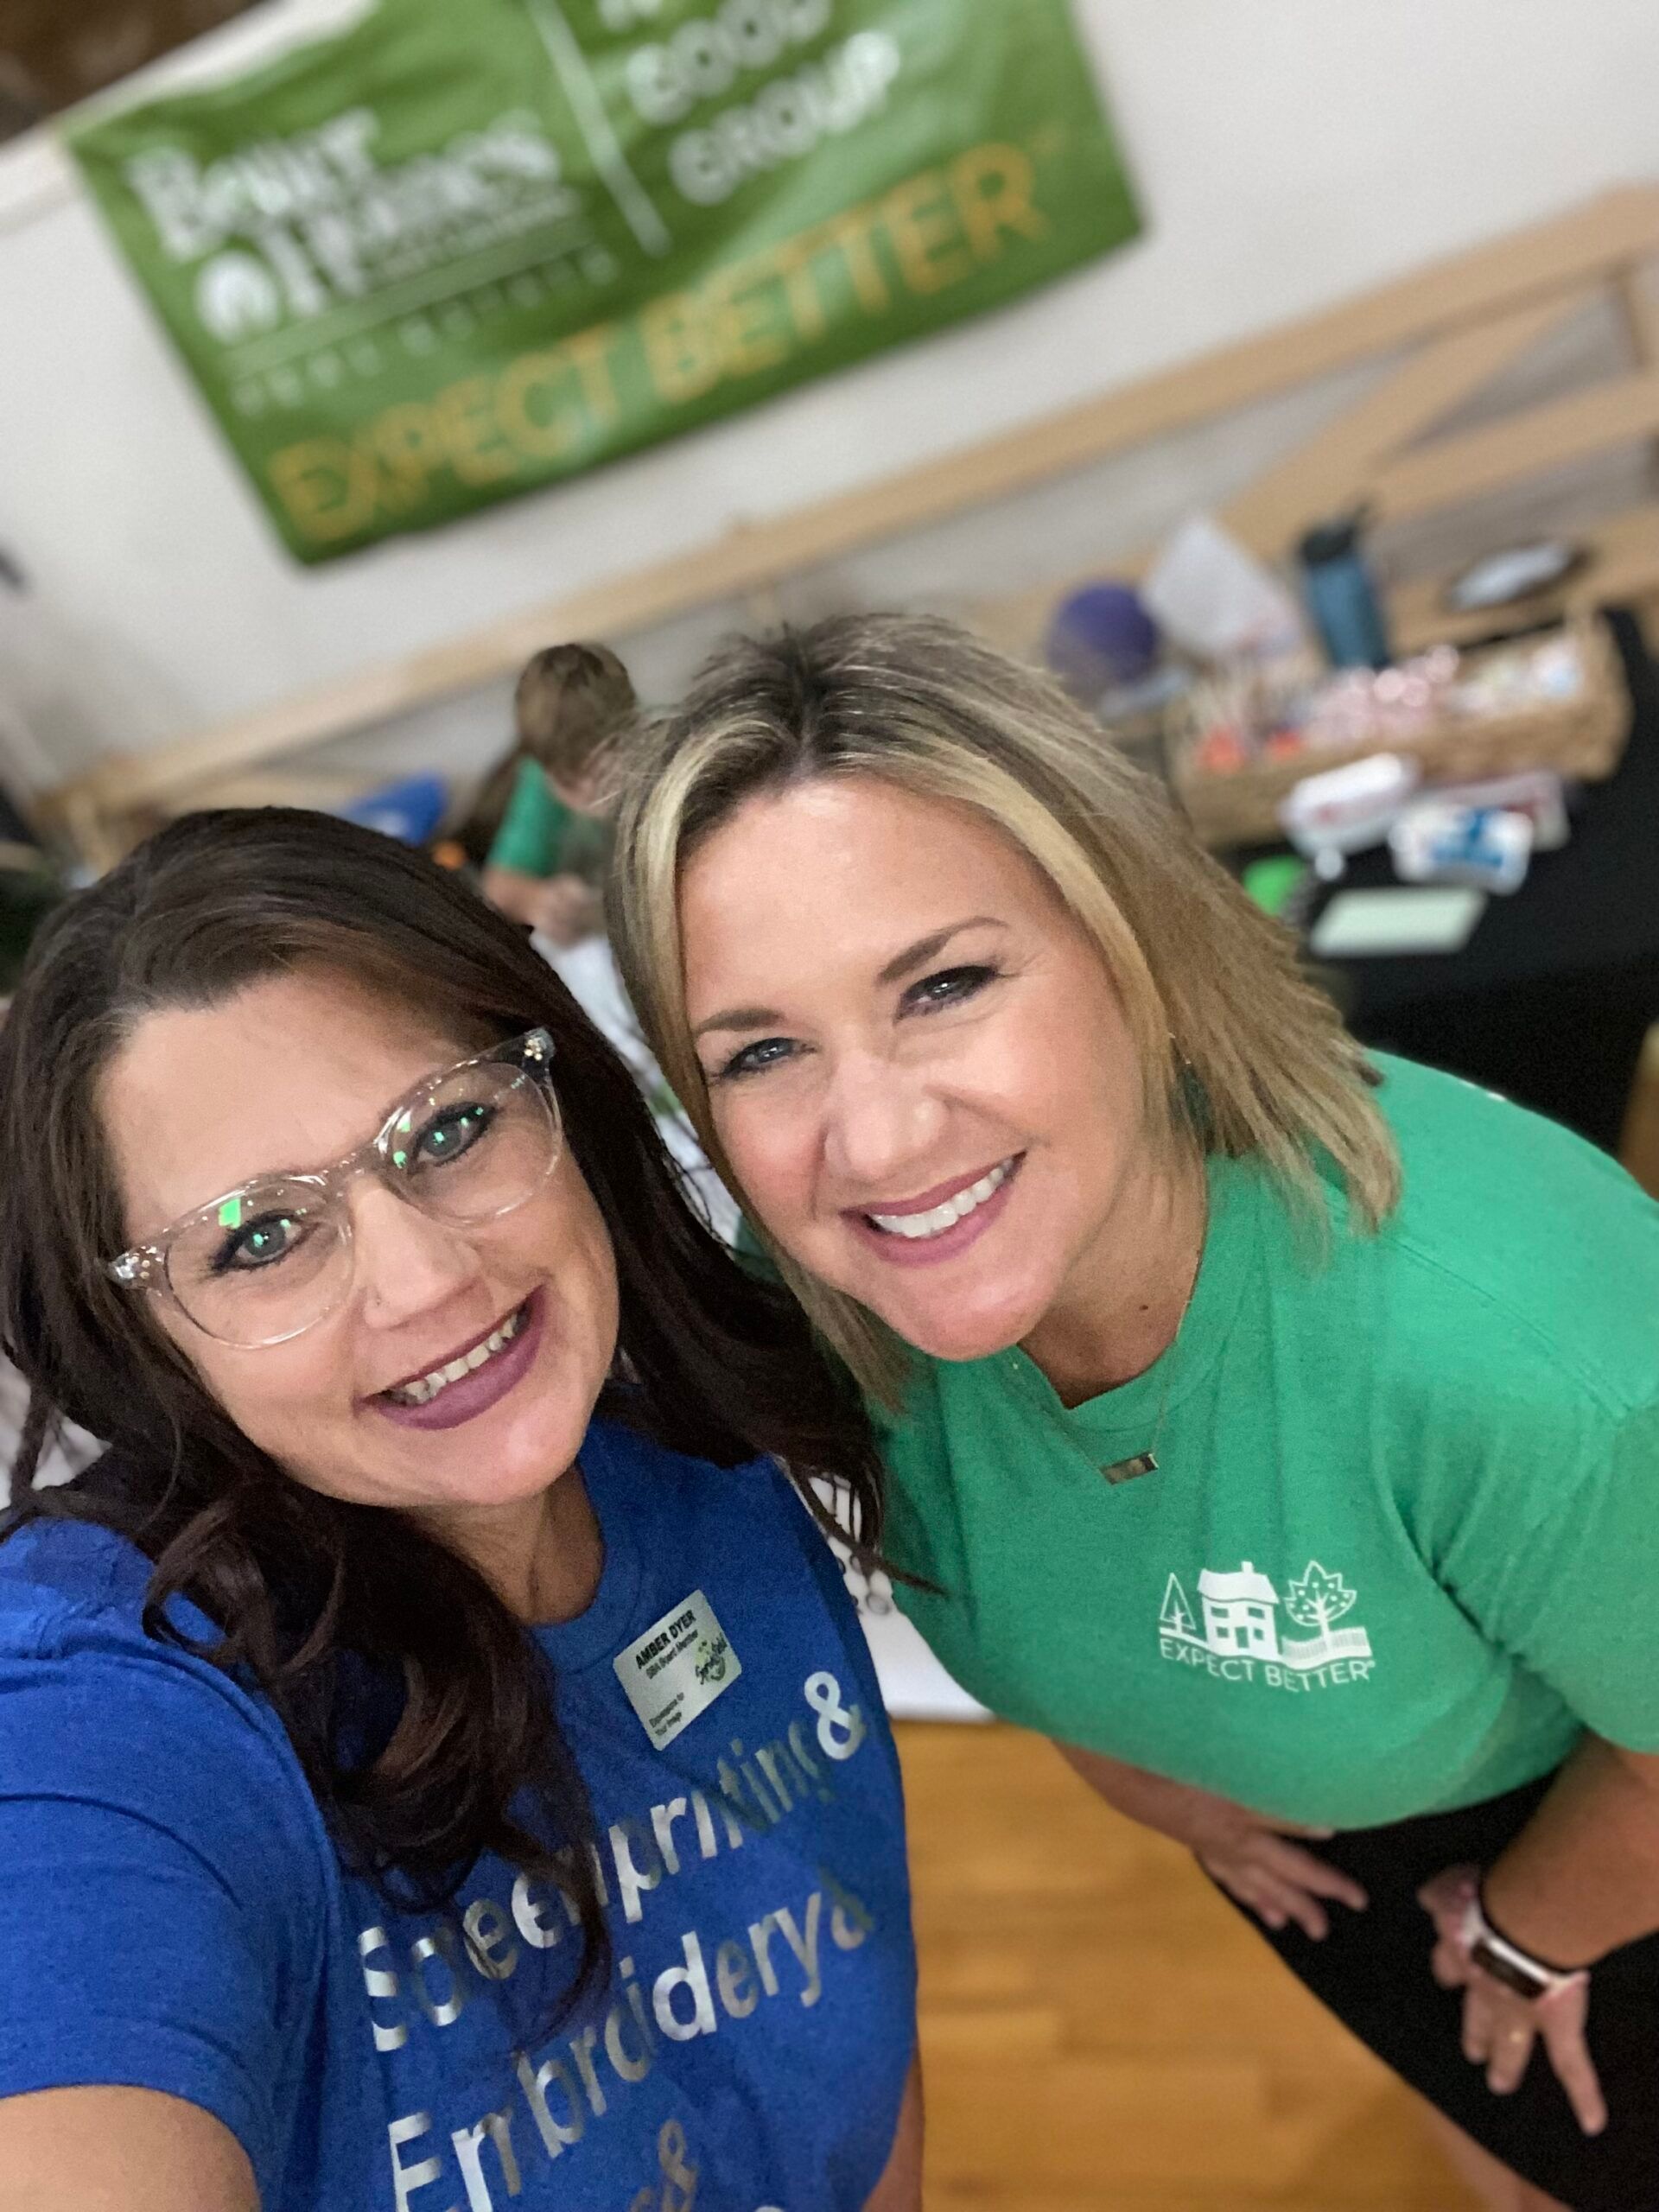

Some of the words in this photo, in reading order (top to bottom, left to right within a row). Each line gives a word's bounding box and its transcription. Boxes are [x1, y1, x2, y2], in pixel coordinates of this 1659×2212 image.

[668, 29, 901, 207] GROUP
[268, 324, 624, 543] EXPECT
[636, 142, 1052, 406] BETTER
[635, 1632, 671, 1669] AMBER
[668, 1609, 696, 1638] DYER
[1159, 1637, 1255, 1682] EXPECT
